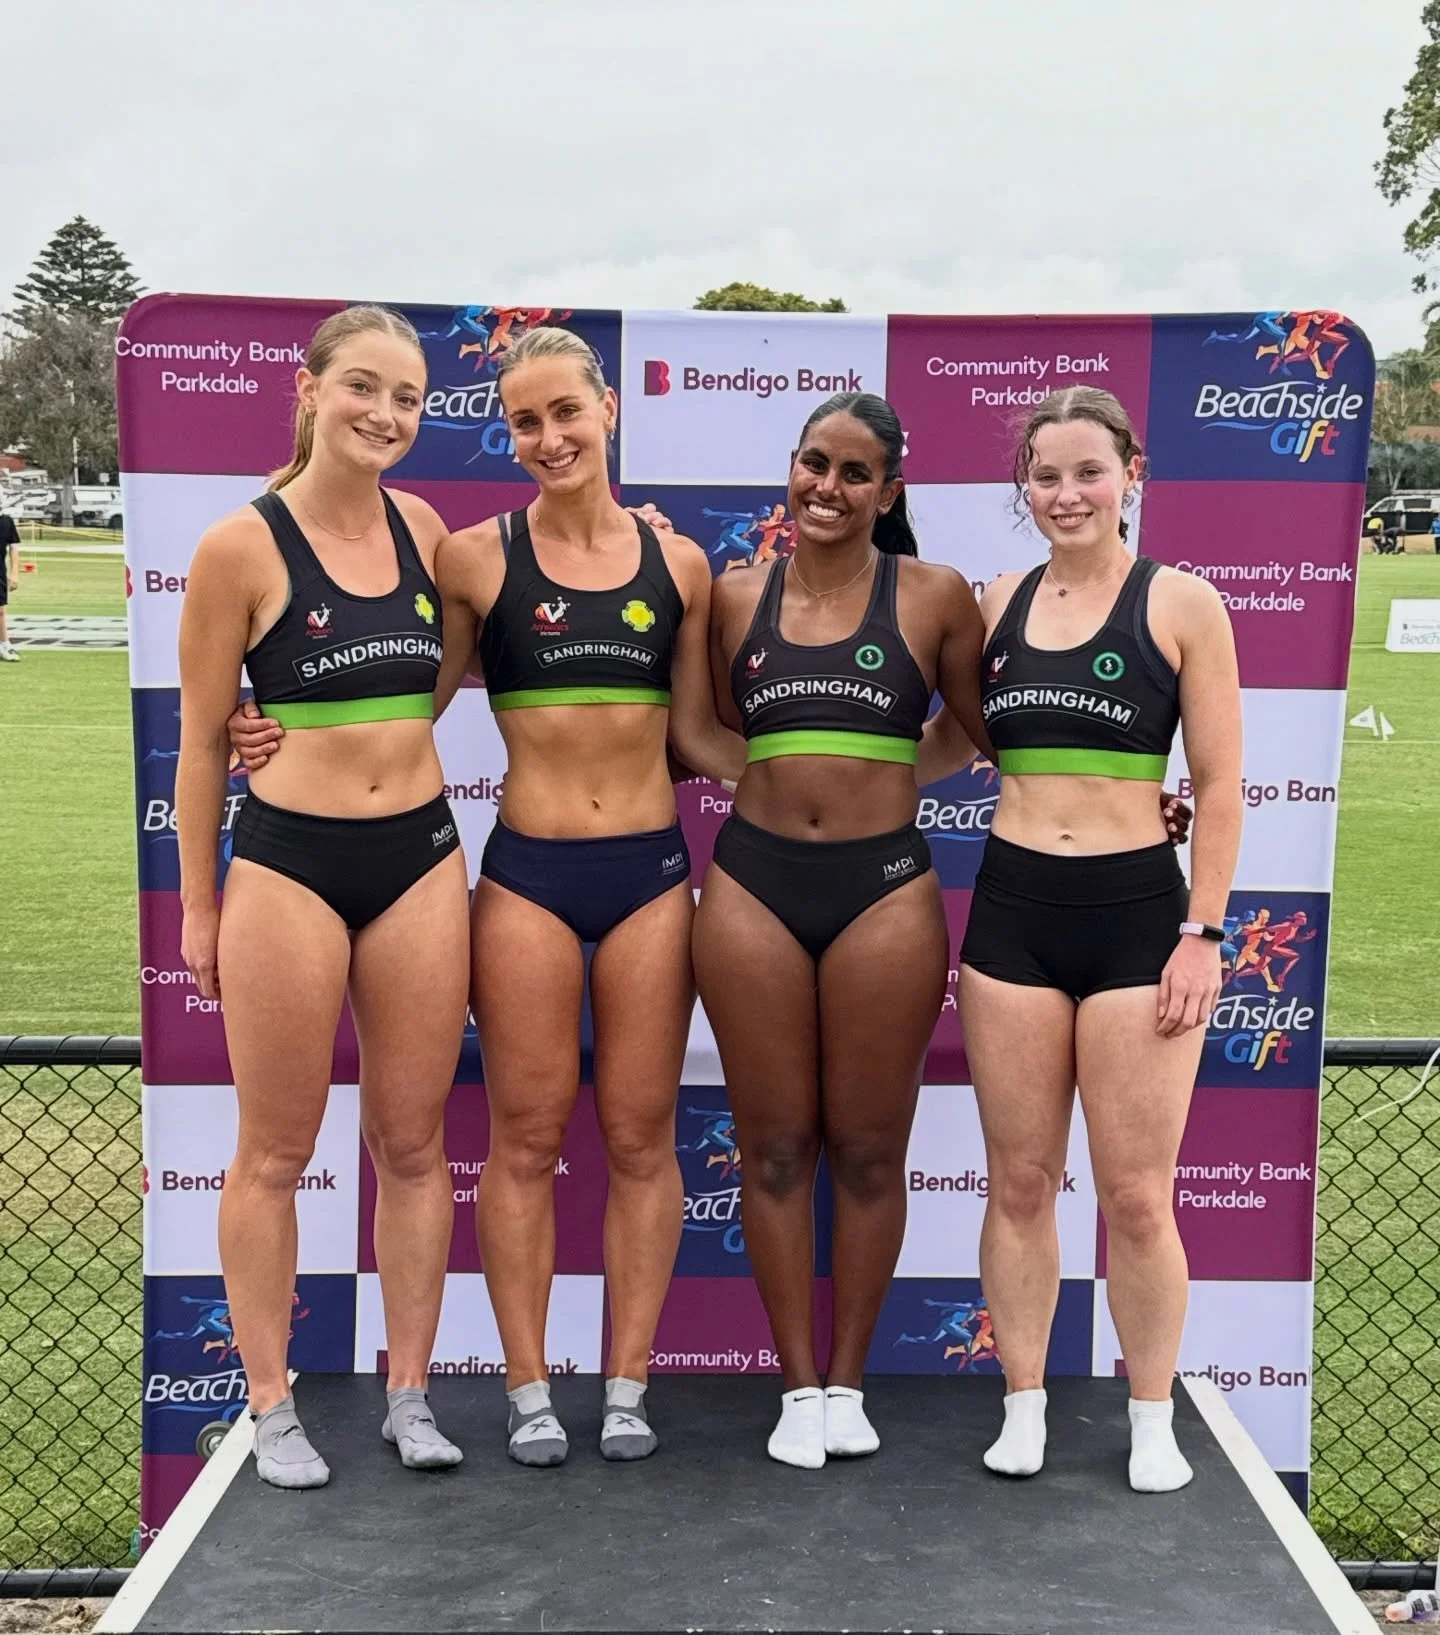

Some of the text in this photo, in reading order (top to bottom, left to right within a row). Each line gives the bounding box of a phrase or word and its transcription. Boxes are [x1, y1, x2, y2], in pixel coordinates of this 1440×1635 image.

[114, 336, 305, 368] Community Bank
[926, 353, 1109, 380] Community Bank
[161, 371, 259, 394] Parkdale
[683, 367, 789, 398] Bendigo
[797, 368, 862, 392] Bank
[971, 385, 1050, 406] Parkdal
[1194, 381, 1363, 420] Beachside
[1269, 420, 1340, 463] Gift
[1300, 562, 1353, 582] Bank
[1219, 592, 1305, 613] Parkdale
[301, 638, 443, 678] SANDRINGHAM
[543, 644, 652, 665] SANDRINGHAM
[745, 680, 892, 714] SANDRINGHAM
[982, 689, 1132, 723] SANDRINGHAM
[1178, 778, 1336, 807] Bigo Ban
[882, 855, 915, 876] IMPI
[1207, 996, 1314, 1030] chside
[1224, 1030, 1292, 1071] Gift
[162, 1168, 336, 1191] Bend ank
[909, 1170, 989, 1198] Bendig
[1174, 1162, 1311, 1185] mmunity Bank
[1179, 1190, 1267, 1209] Parkdale
[144, 1369, 247, 1403] Beach
[1259, 1366, 1311, 1387] Ban
